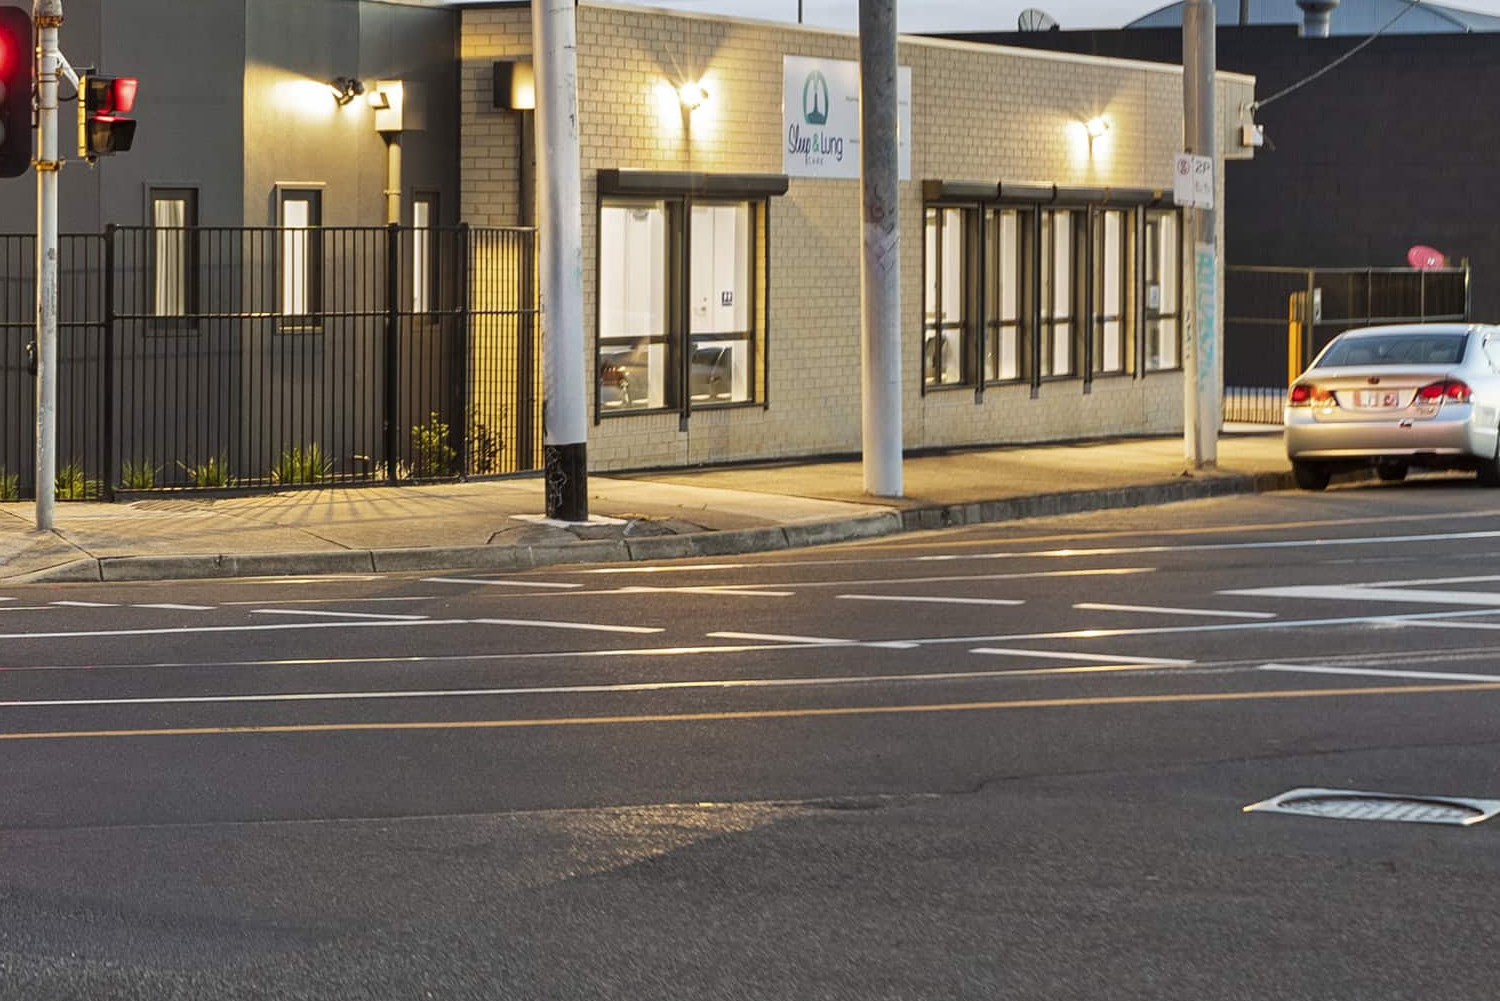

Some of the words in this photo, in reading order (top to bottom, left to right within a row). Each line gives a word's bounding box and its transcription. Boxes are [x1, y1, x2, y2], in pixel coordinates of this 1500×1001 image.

[787, 123, 811, 166] Sleep
[812, 133, 820, 152] &
[820, 131, 843, 162] Lung
